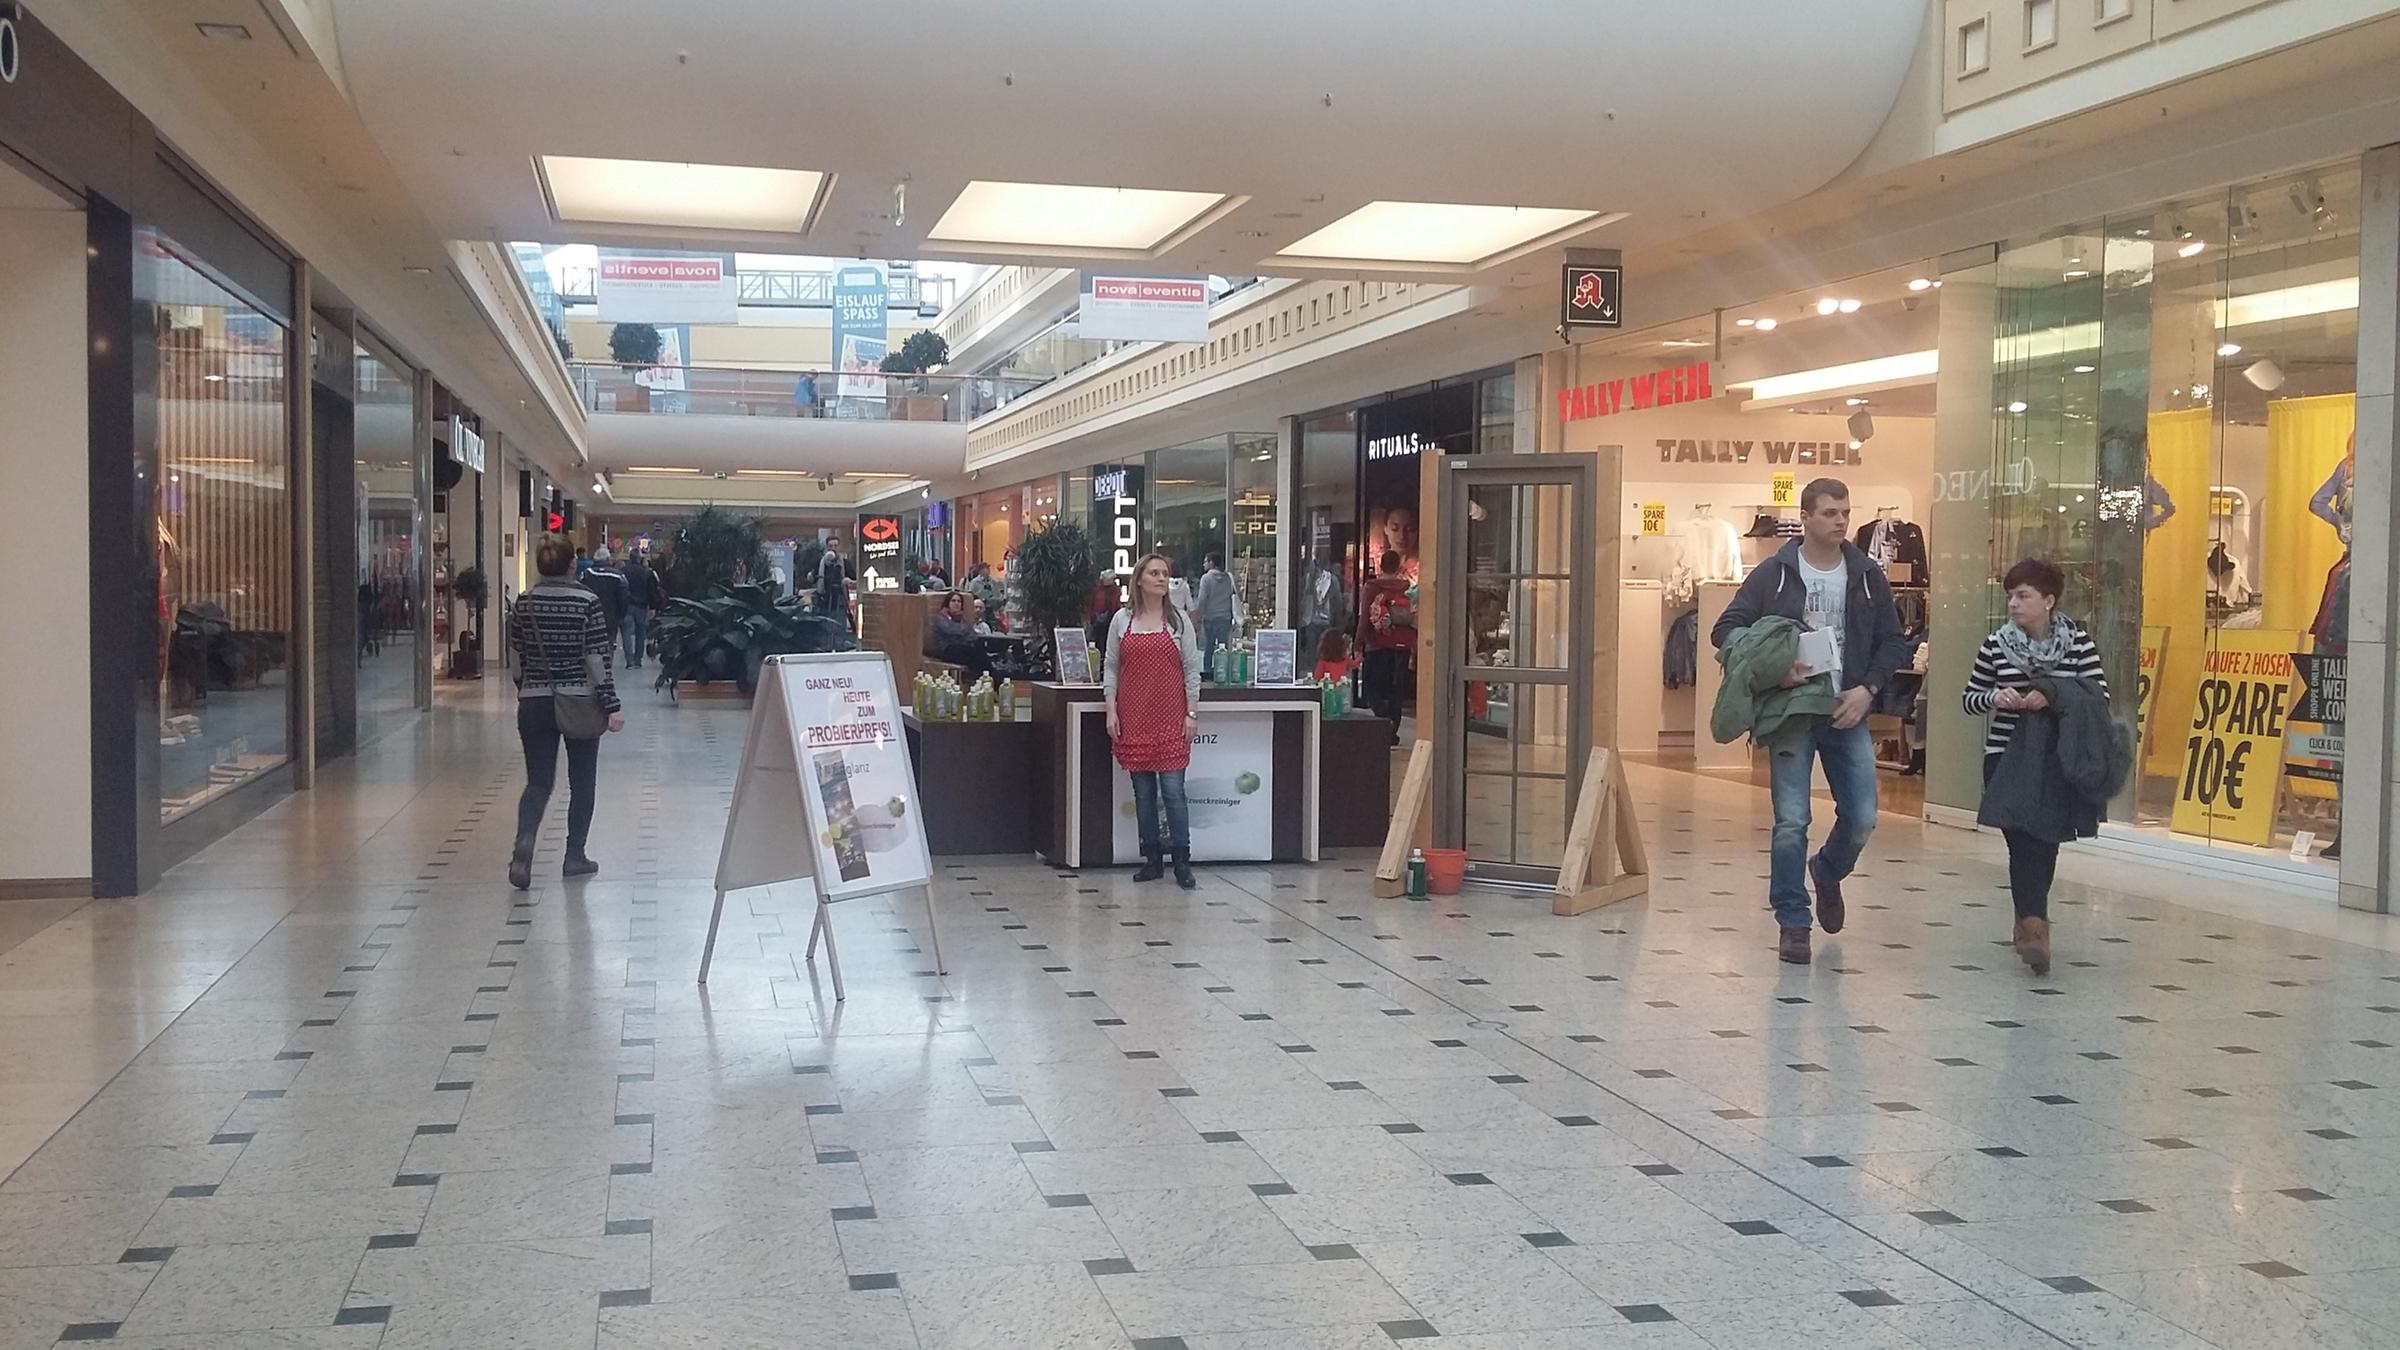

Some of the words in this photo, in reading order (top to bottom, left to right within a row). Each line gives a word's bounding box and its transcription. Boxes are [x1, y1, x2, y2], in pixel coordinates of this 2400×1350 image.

[1098, 285, 1137, 295] nova
[835, 294, 885, 308] EISLAUF
[843, 307, 879, 321] SPASS
[1557, 378, 1625, 423] TALLY
[1655, 439, 1754, 464] TALLY
[1773, 480, 1793, 490] SPARE
[1773, 490, 1788, 502] 10€
[1643, 510, 1665, 520] SPARE
[1643, 519, 1659, 532] 10€
[2204, 650, 2242, 674] KAUFE
[2242, 652, 2250, 674] 2
[2252, 653, 2292, 677] HOSEN
[805, 678, 832, 690] GANZ
[833, 677, 853, 689] NEU!
[843, 691, 872, 703] HEUTE
[857, 705, 876, 718] ZUM
[2193, 678, 2288, 738] SPARE
[2182, 736, 2252, 810] 10€
